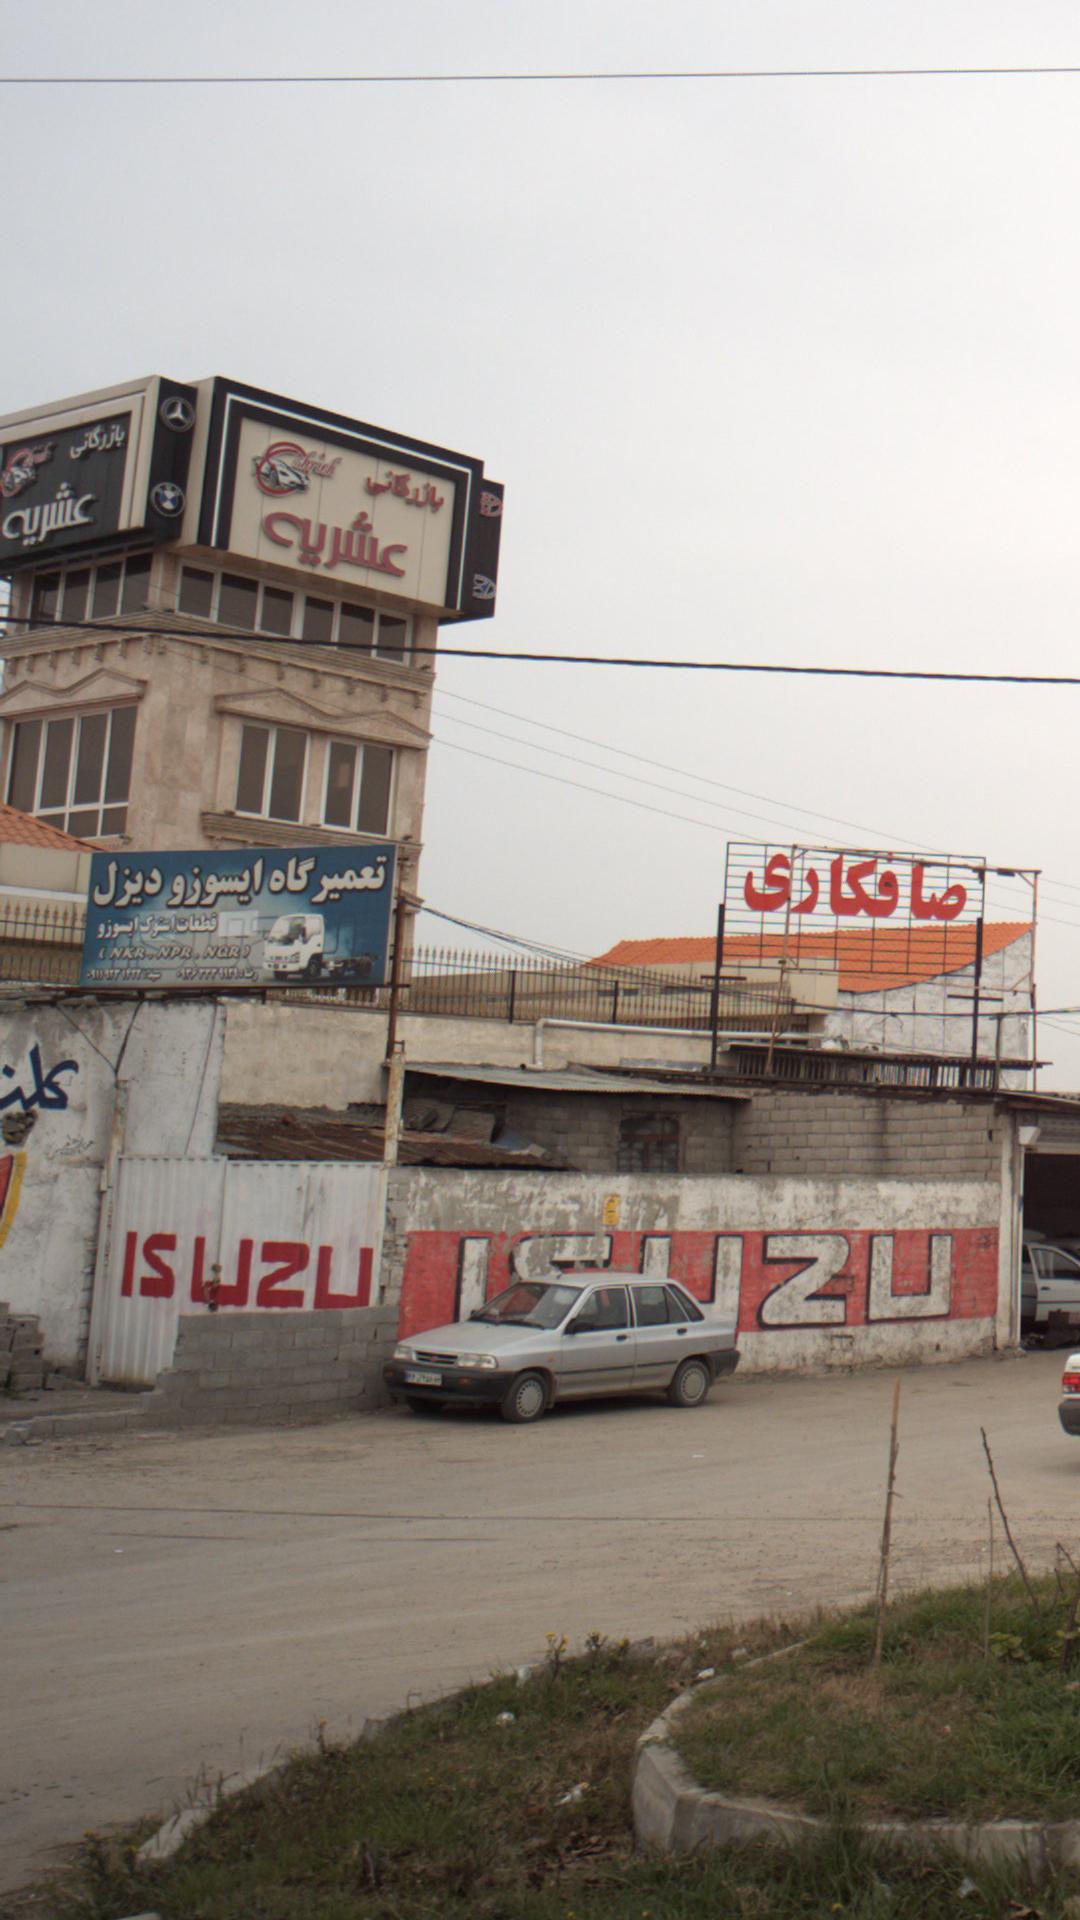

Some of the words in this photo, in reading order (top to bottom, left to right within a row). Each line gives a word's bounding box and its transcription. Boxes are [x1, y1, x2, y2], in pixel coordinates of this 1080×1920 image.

[70, 424, 126, 459] بازرگانی
[2, 481, 96, 546] عشریه
[365, 470, 445, 514] بازرگانی
[263, 510, 409, 577] عشریه
[93, 860, 163, 907] دیزل
[166, 857, 264, 907] ایسوزو
[121, 1231, 374, 1309] ISUZU
